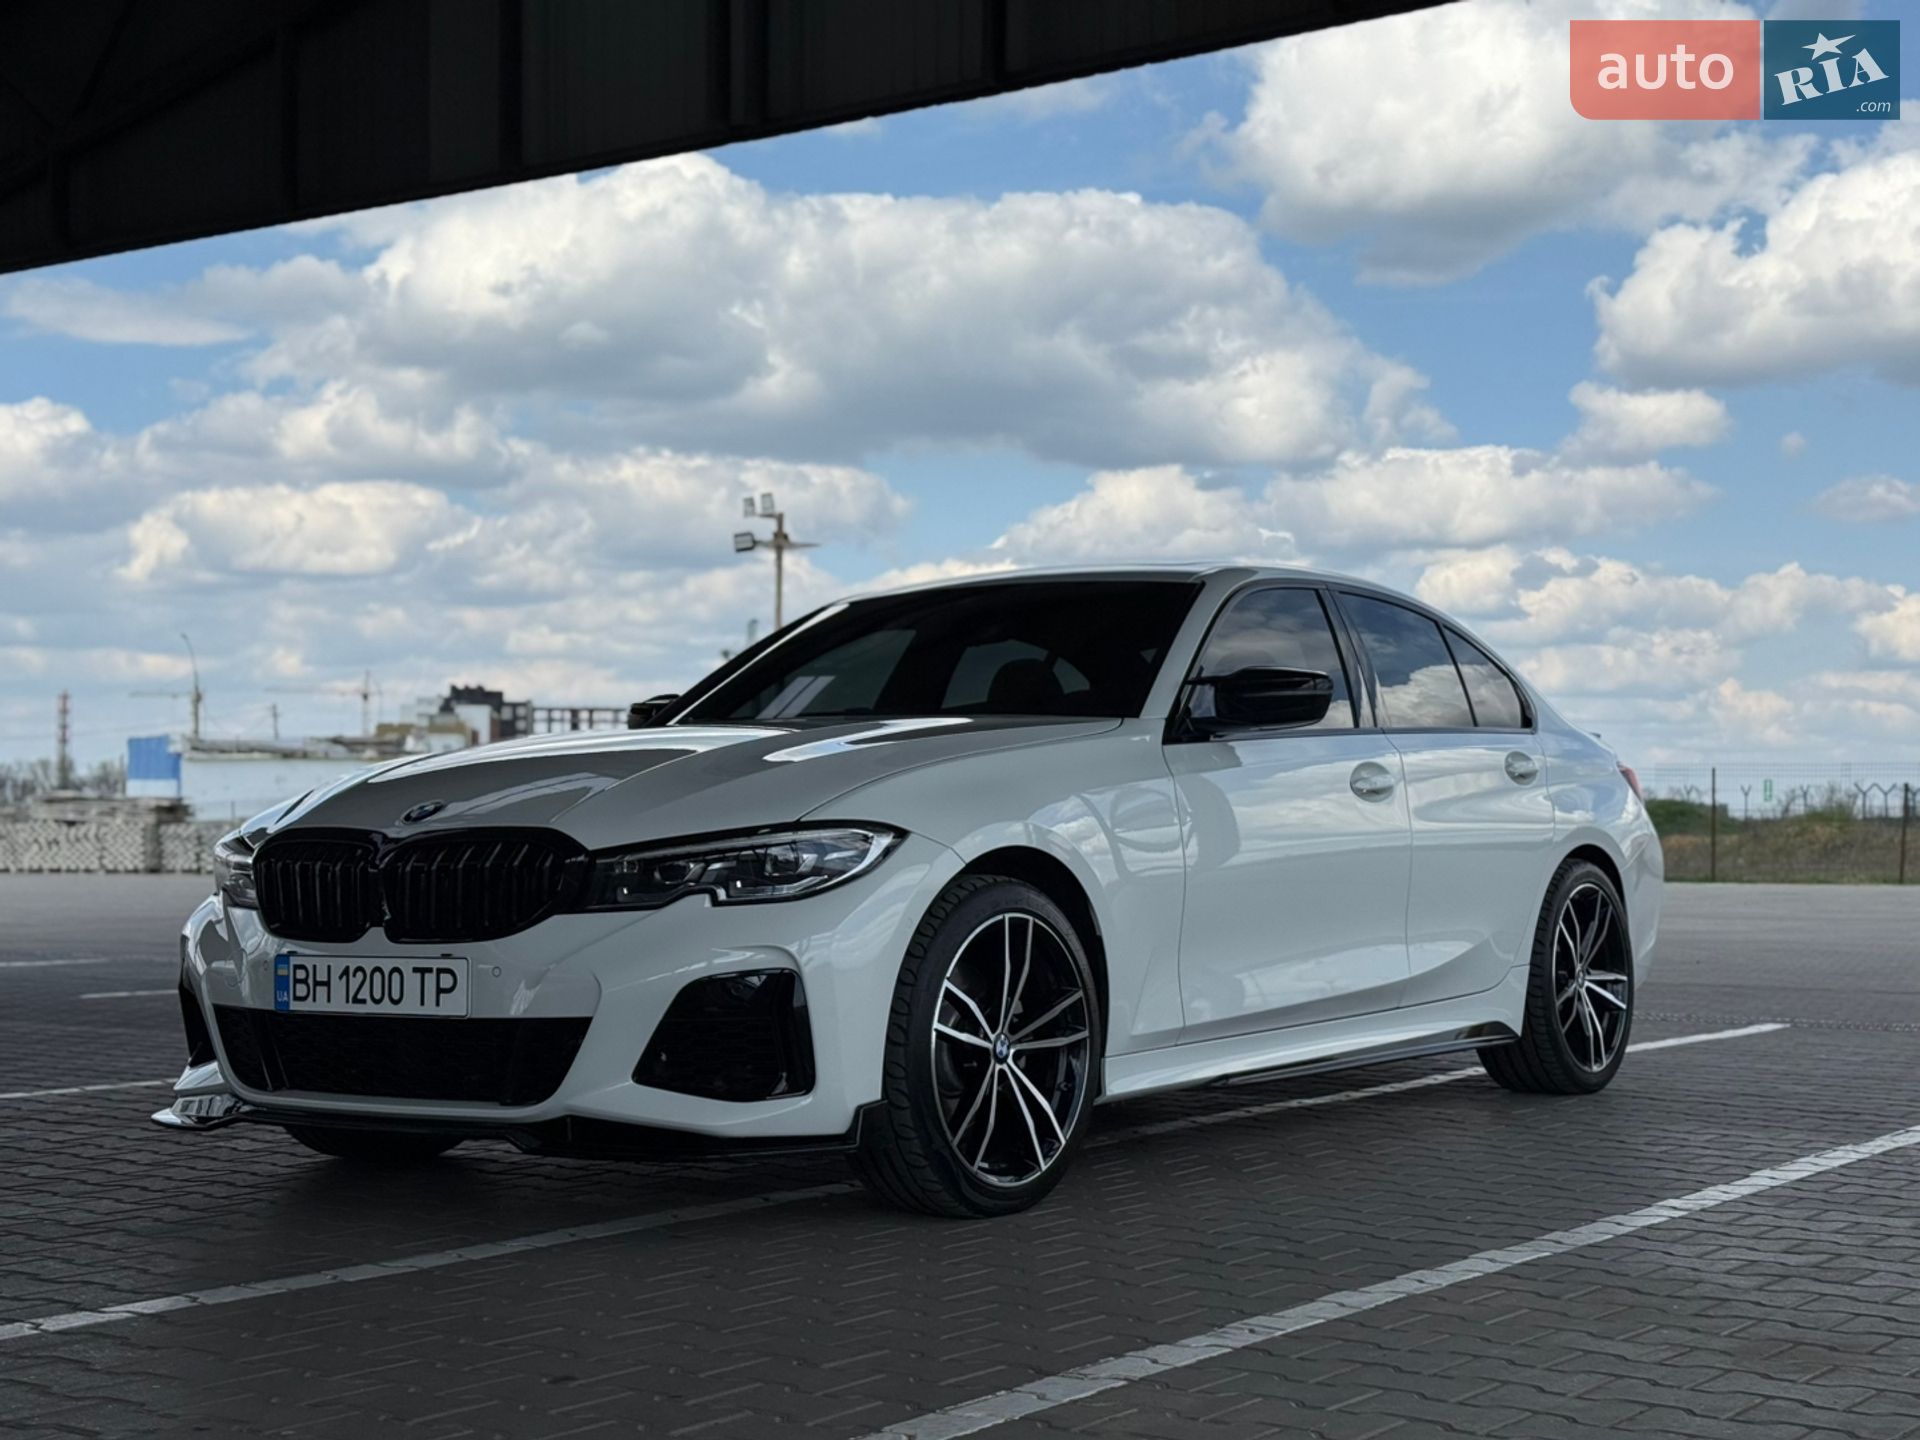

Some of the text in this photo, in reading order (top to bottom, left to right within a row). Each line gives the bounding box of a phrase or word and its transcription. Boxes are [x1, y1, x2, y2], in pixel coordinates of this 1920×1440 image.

[276, 990, 289, 1002] UA
[292, 963, 458, 1008] BH 1200 TP
